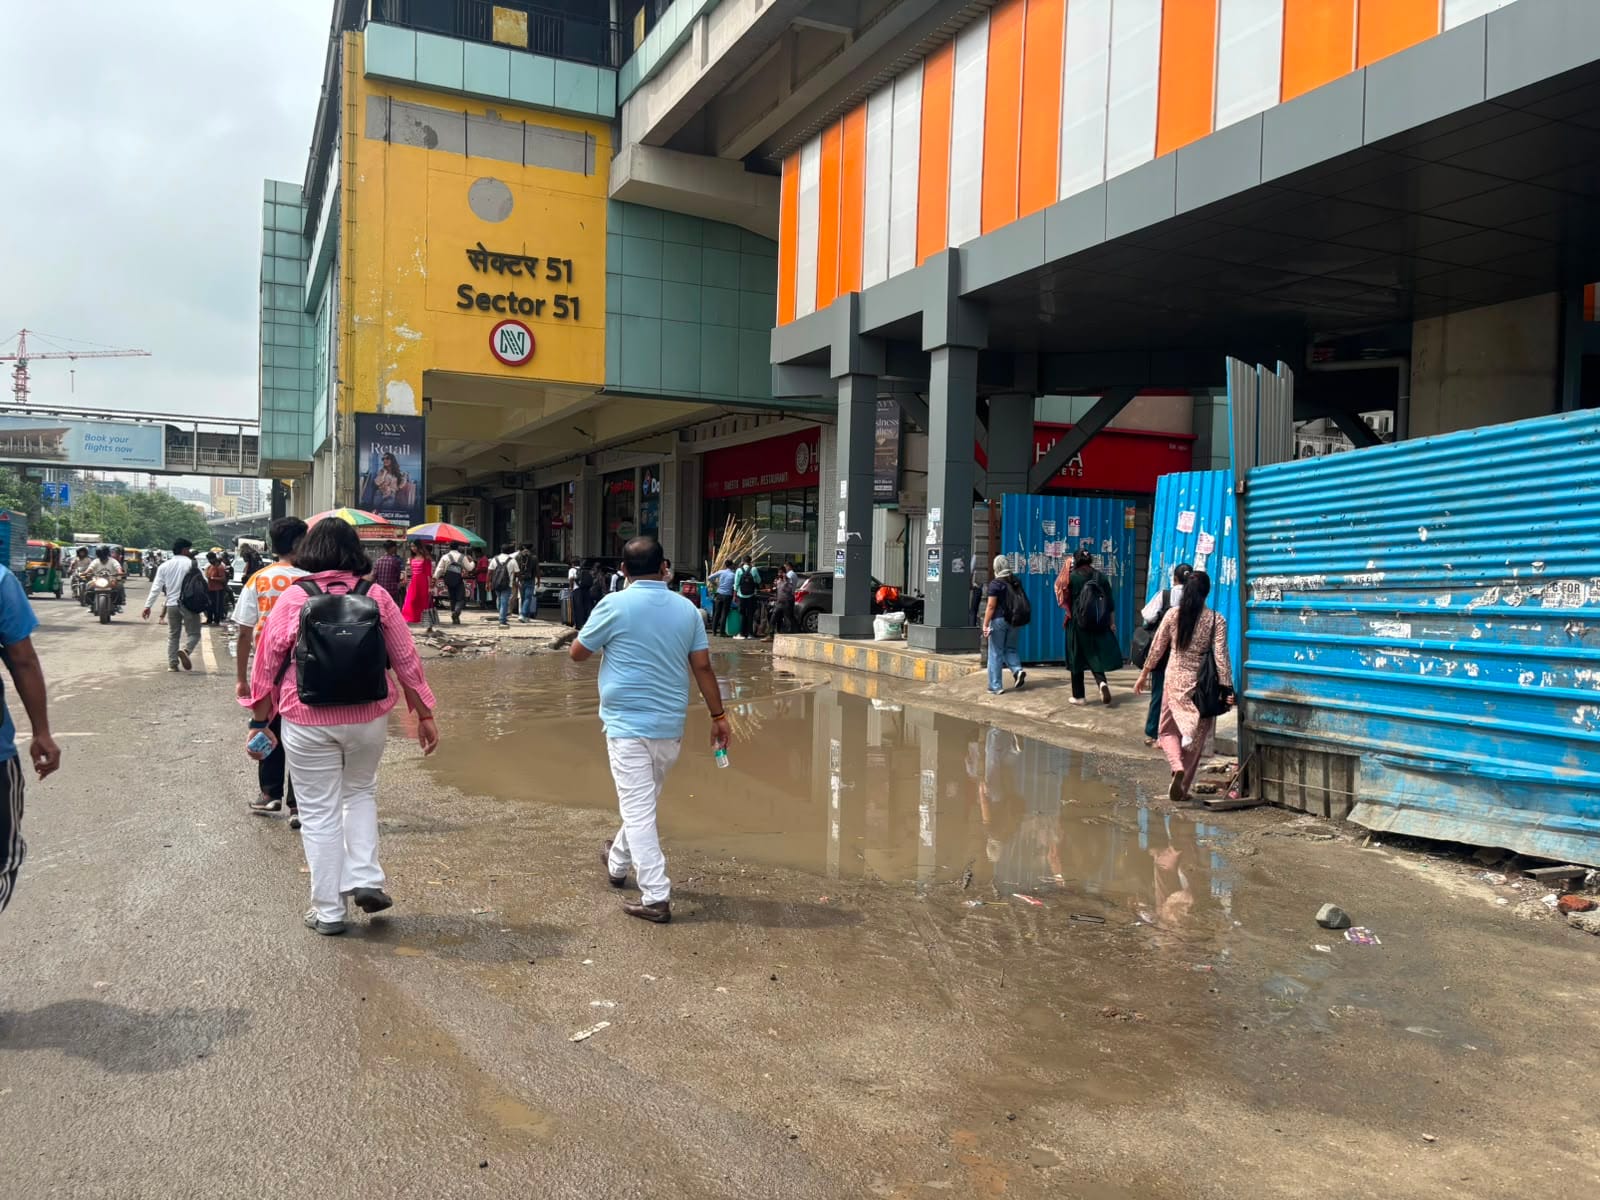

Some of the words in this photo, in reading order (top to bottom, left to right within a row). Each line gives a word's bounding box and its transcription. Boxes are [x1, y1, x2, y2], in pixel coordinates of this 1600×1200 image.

[466, 242, 538, 277] सेक्टर
[546, 257, 573, 283] 51
[457, 283, 546, 317] Sector
[552, 295, 580, 320] 51
[375, 423, 407, 432] ONYX
[84, 433, 106, 443] Book
[108, 435, 130, 445] your
[84, 443, 114, 454] flights
[114, 446, 134, 454] now
[371, 442, 410, 456] Retail
[1545, 582, 1558, 593] PG
[1562, 582, 1581, 594] FOR
